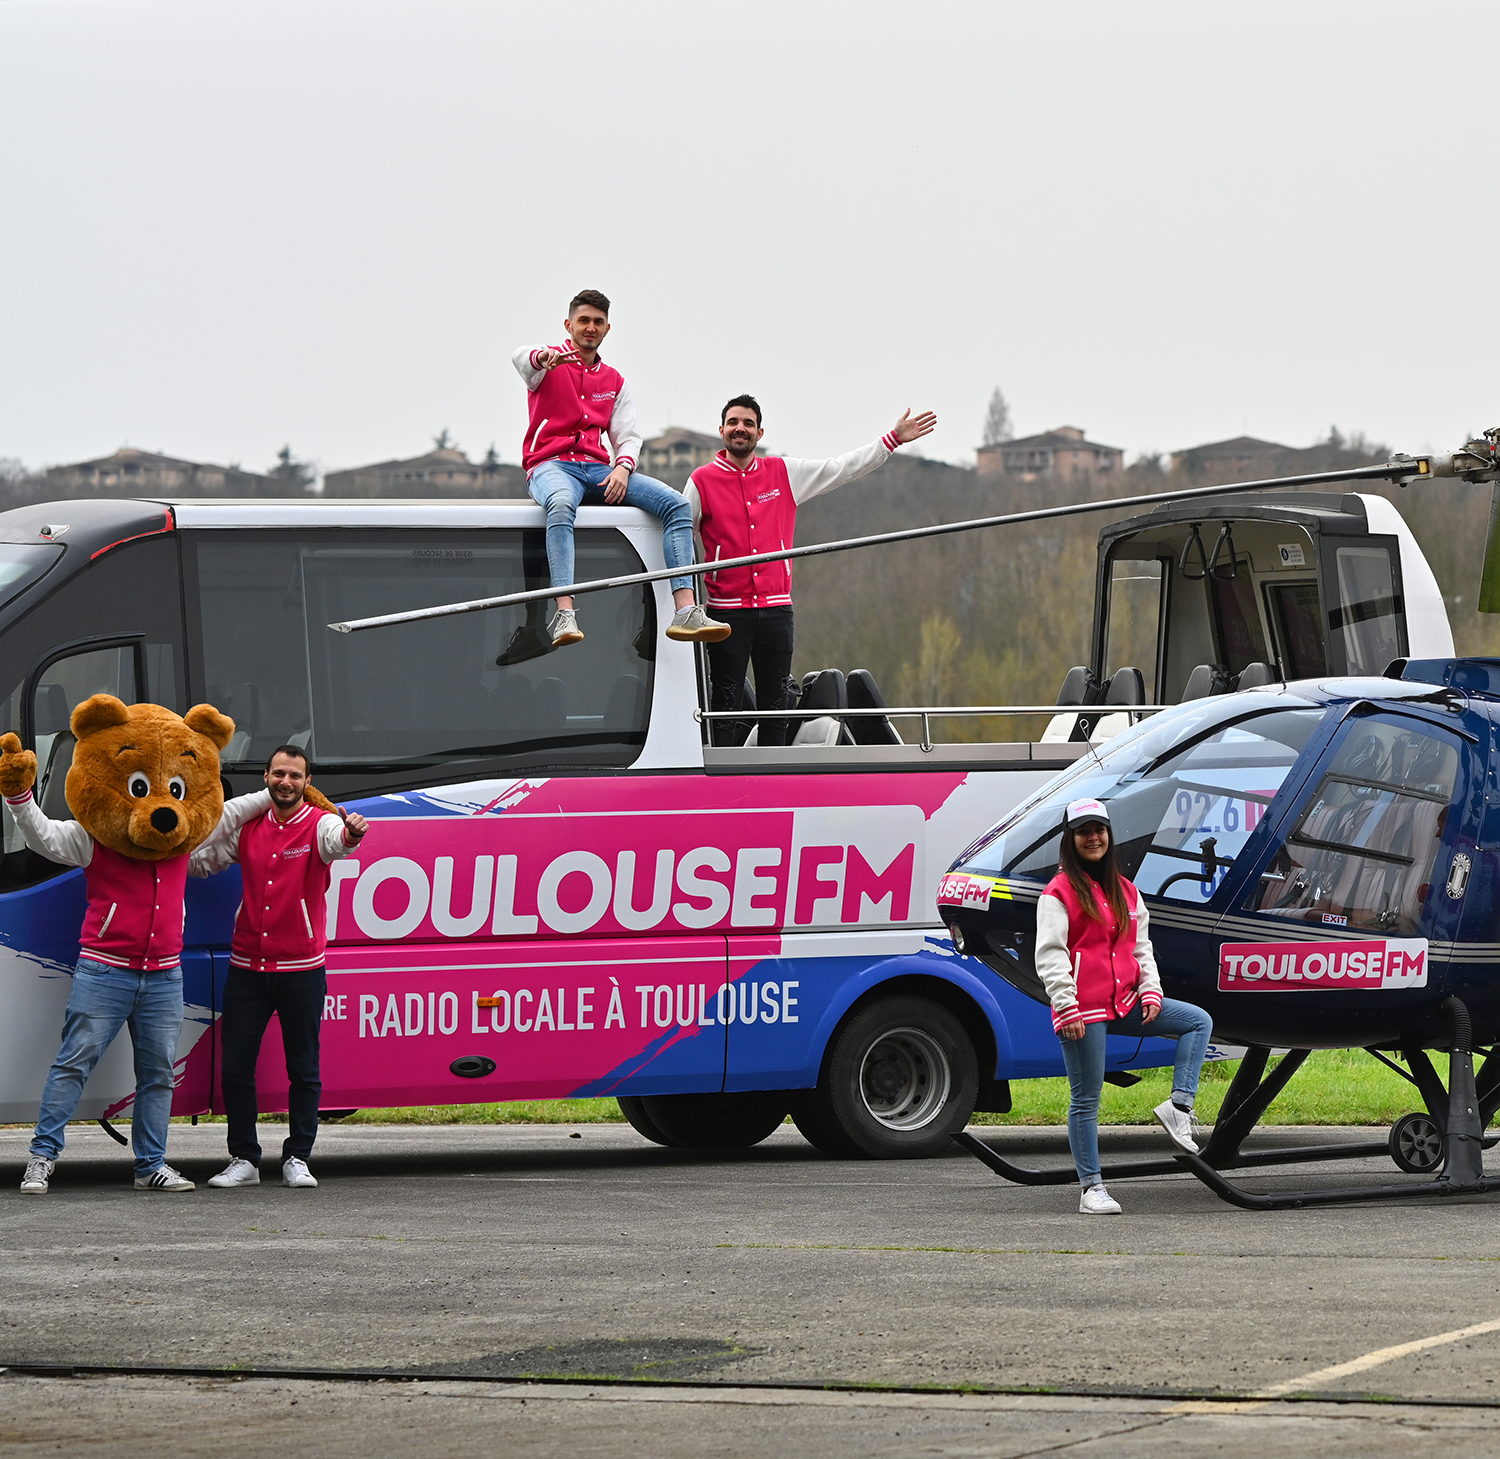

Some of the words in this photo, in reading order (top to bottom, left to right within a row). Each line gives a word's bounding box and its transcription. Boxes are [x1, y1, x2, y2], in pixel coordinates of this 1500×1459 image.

[1176, 791, 1239, 833] 92.6
[325, 847, 782, 941] TOULOUSE
[794, 843, 916, 924] FM
[965, 884, 991, 904] FM
[1323, 914, 1347, 924] EXIT
[1225, 952, 1383, 981] TOULOUSE
[1386, 950, 1425, 977] FM
[320, 995, 347, 1020] RE
[359, 991, 458, 1038] RADIO
[472, 986, 595, 1034] LOCALE
[604, 976, 626, 1029] À
[635, 981, 799, 1028] TOULOUSE
